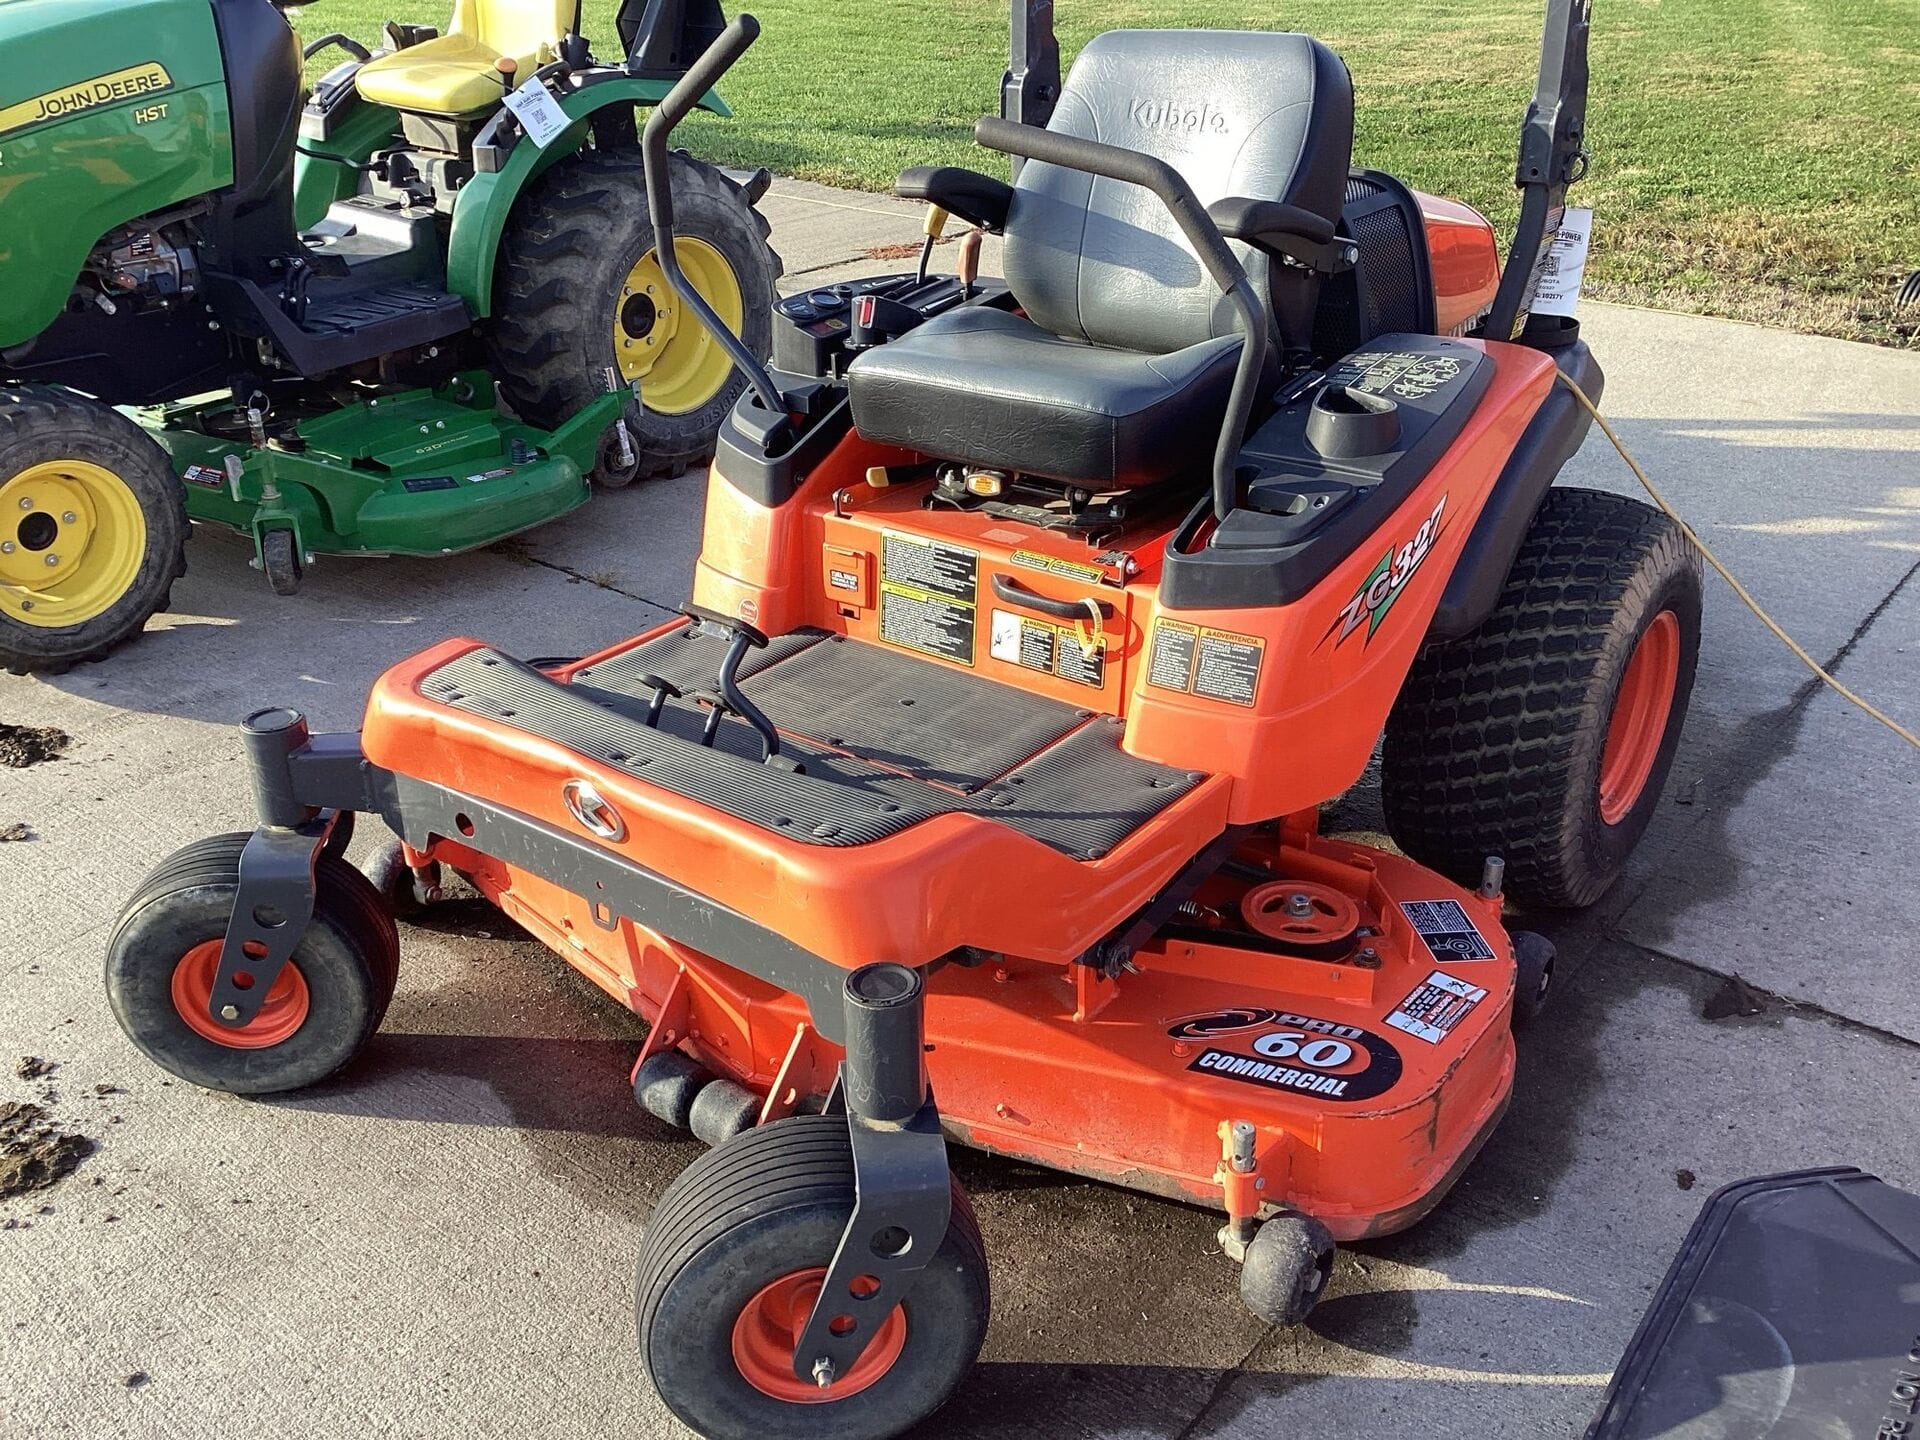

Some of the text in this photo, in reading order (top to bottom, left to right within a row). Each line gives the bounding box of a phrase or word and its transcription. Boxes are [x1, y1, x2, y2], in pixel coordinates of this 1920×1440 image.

[35, 73, 162, 120] JOHN DEERE
[134, 104, 169, 125] HST
[1335, 489, 1449, 649] ZG327
[1165, 621, 1195, 632] WARNING
[1212, 631, 1258, 645] ADVERTENCIA
[1275, 1013, 1365, 1039] PRO
[1253, 1032, 1352, 1067] 60
[1198, 1052, 1350, 1097] COMMERCIAL
